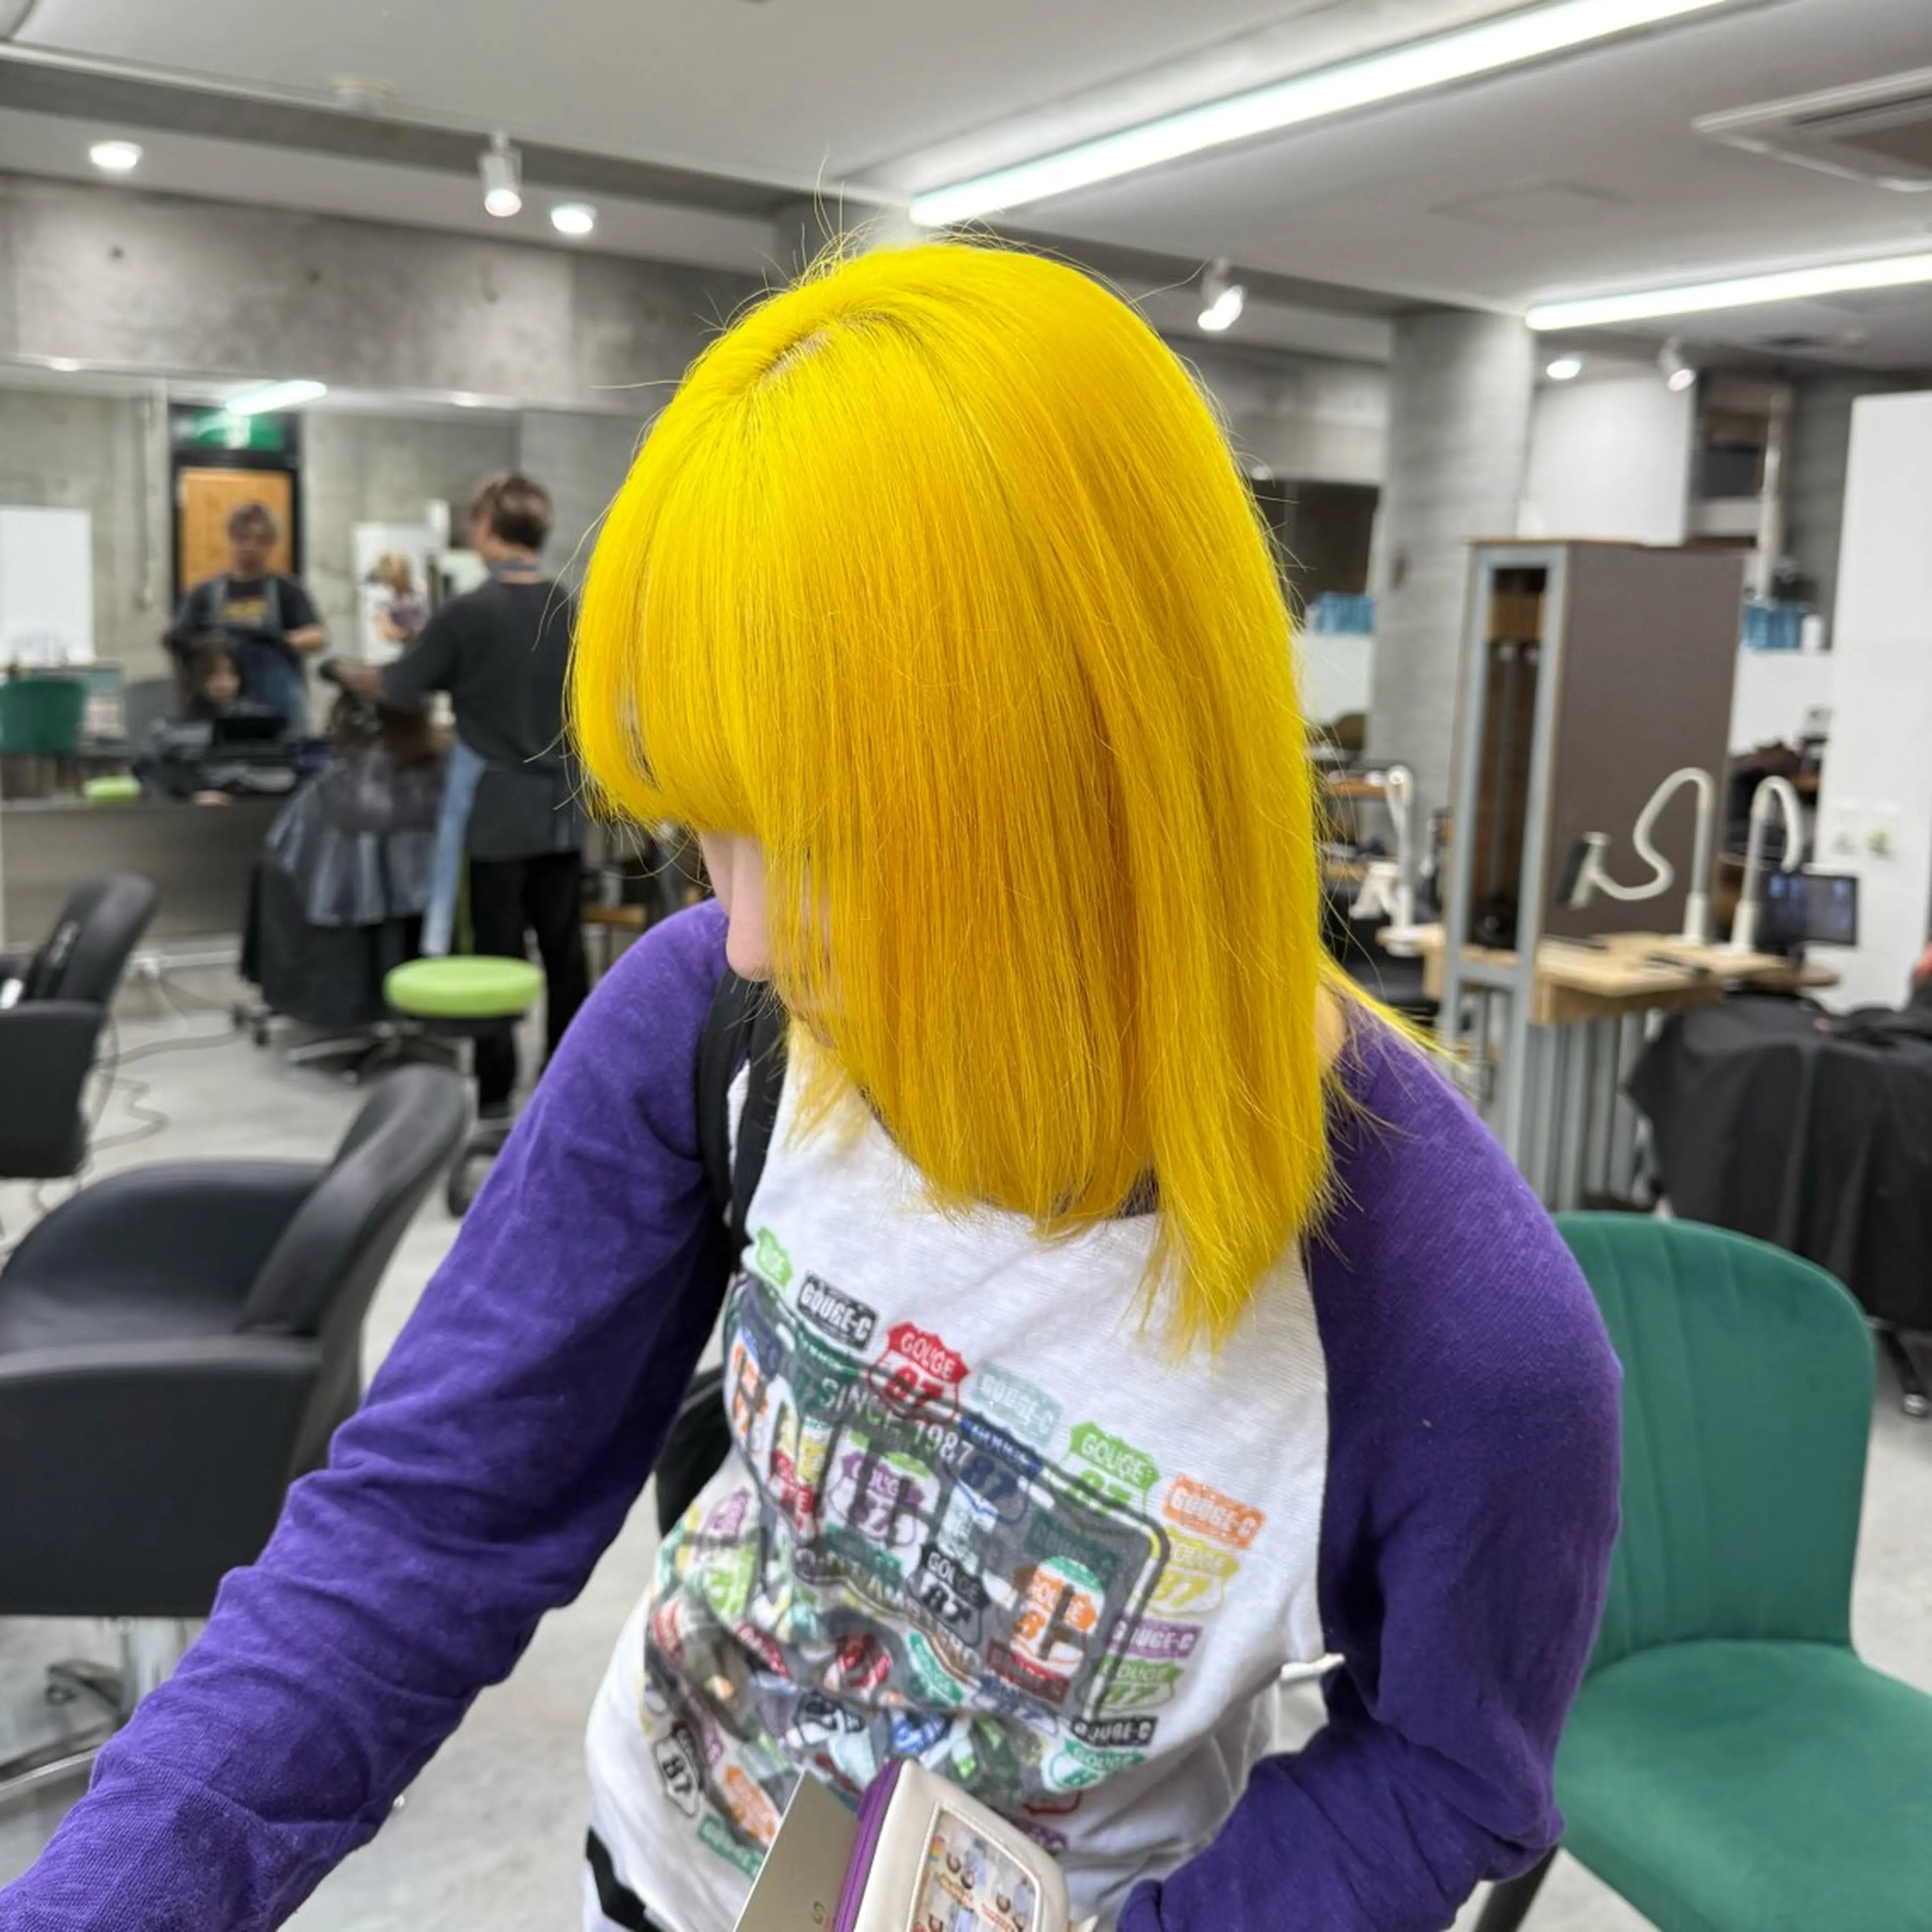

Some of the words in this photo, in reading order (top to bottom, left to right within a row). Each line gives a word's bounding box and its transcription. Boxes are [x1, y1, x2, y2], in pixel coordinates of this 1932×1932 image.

[800, 1282, 873, 1342] GOUGE-C
[900, 1332, 957, 1379] GOUGE
[819, 1378, 902, 1436] SINCE
[913, 1420, 974, 1465] 1987
[1081, 1432, 1144, 1483] GOUGE
